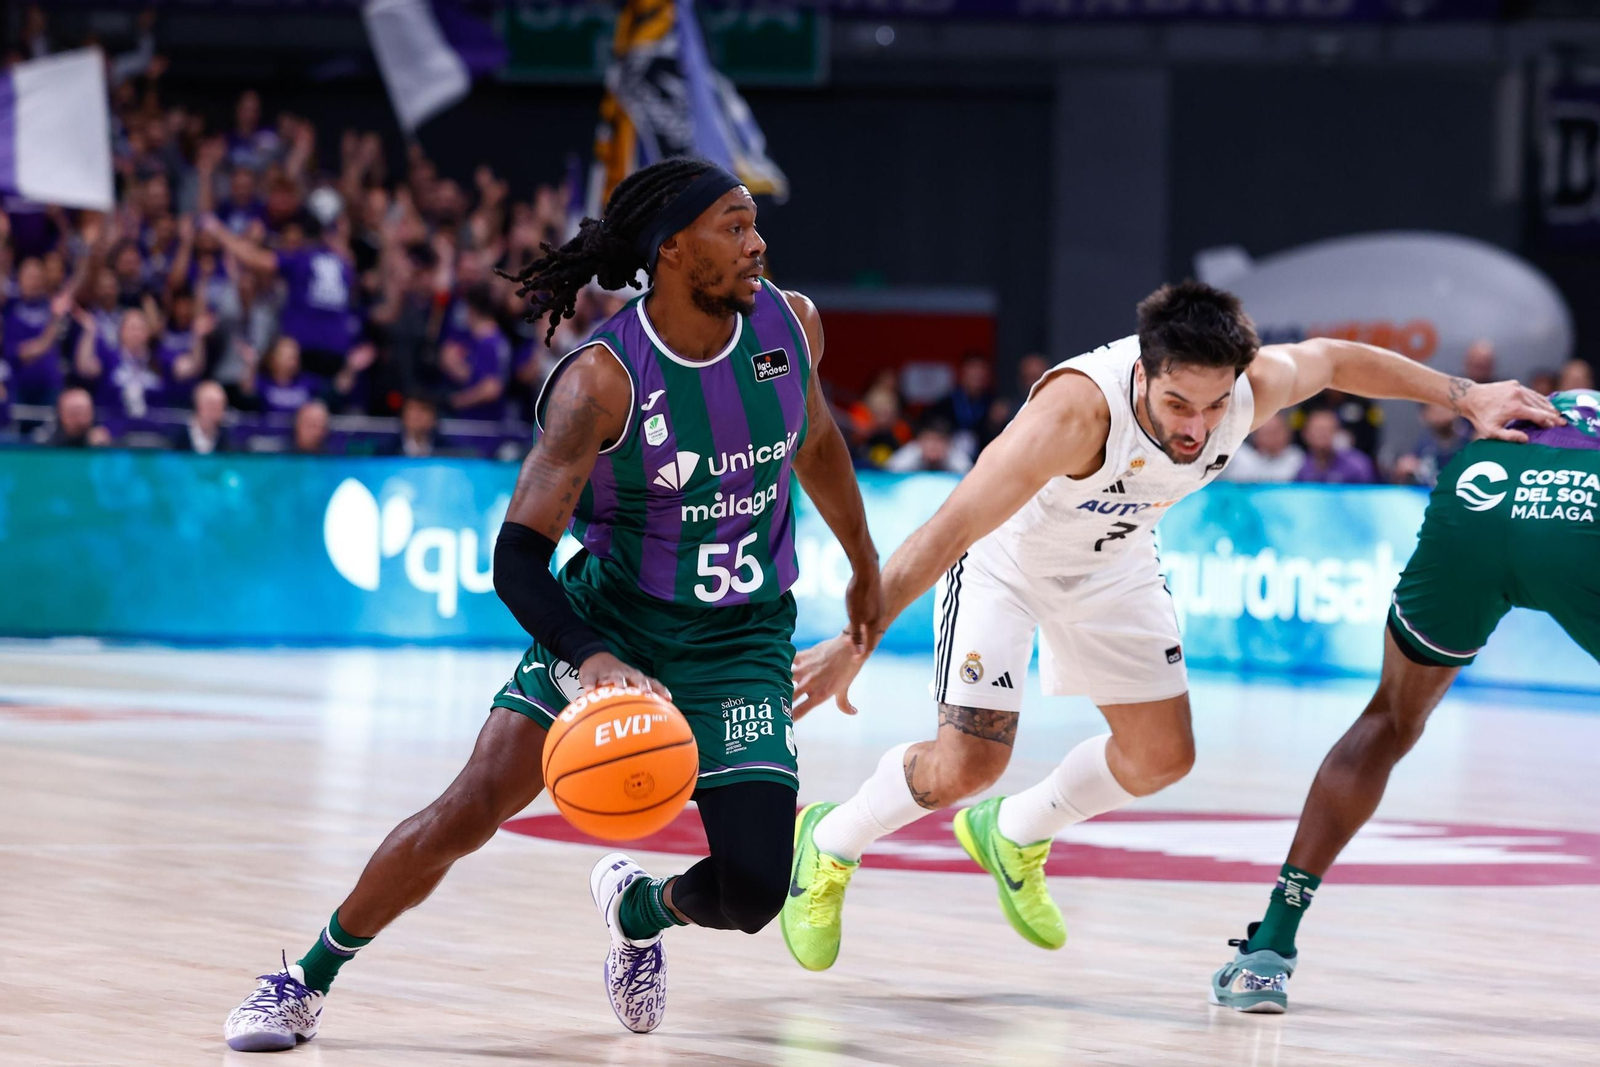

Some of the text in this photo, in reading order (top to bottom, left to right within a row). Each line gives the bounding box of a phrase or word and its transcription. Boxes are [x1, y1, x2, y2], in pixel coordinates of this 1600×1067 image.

[1520, 469, 1600, 491] COSTA
[1514, 487, 1598, 508] DEL SOL
[1511, 502, 1594, 522] MÁLAGA
[1094, 521, 1138, 552] 7
[694, 532, 764, 602] 55
[721, 697, 745, 709] sabor
[722, 709, 730, 718] a
[731, 697, 775, 724] má
[595, 713, 651, 747] EVO
[723, 719, 775, 743] laga
